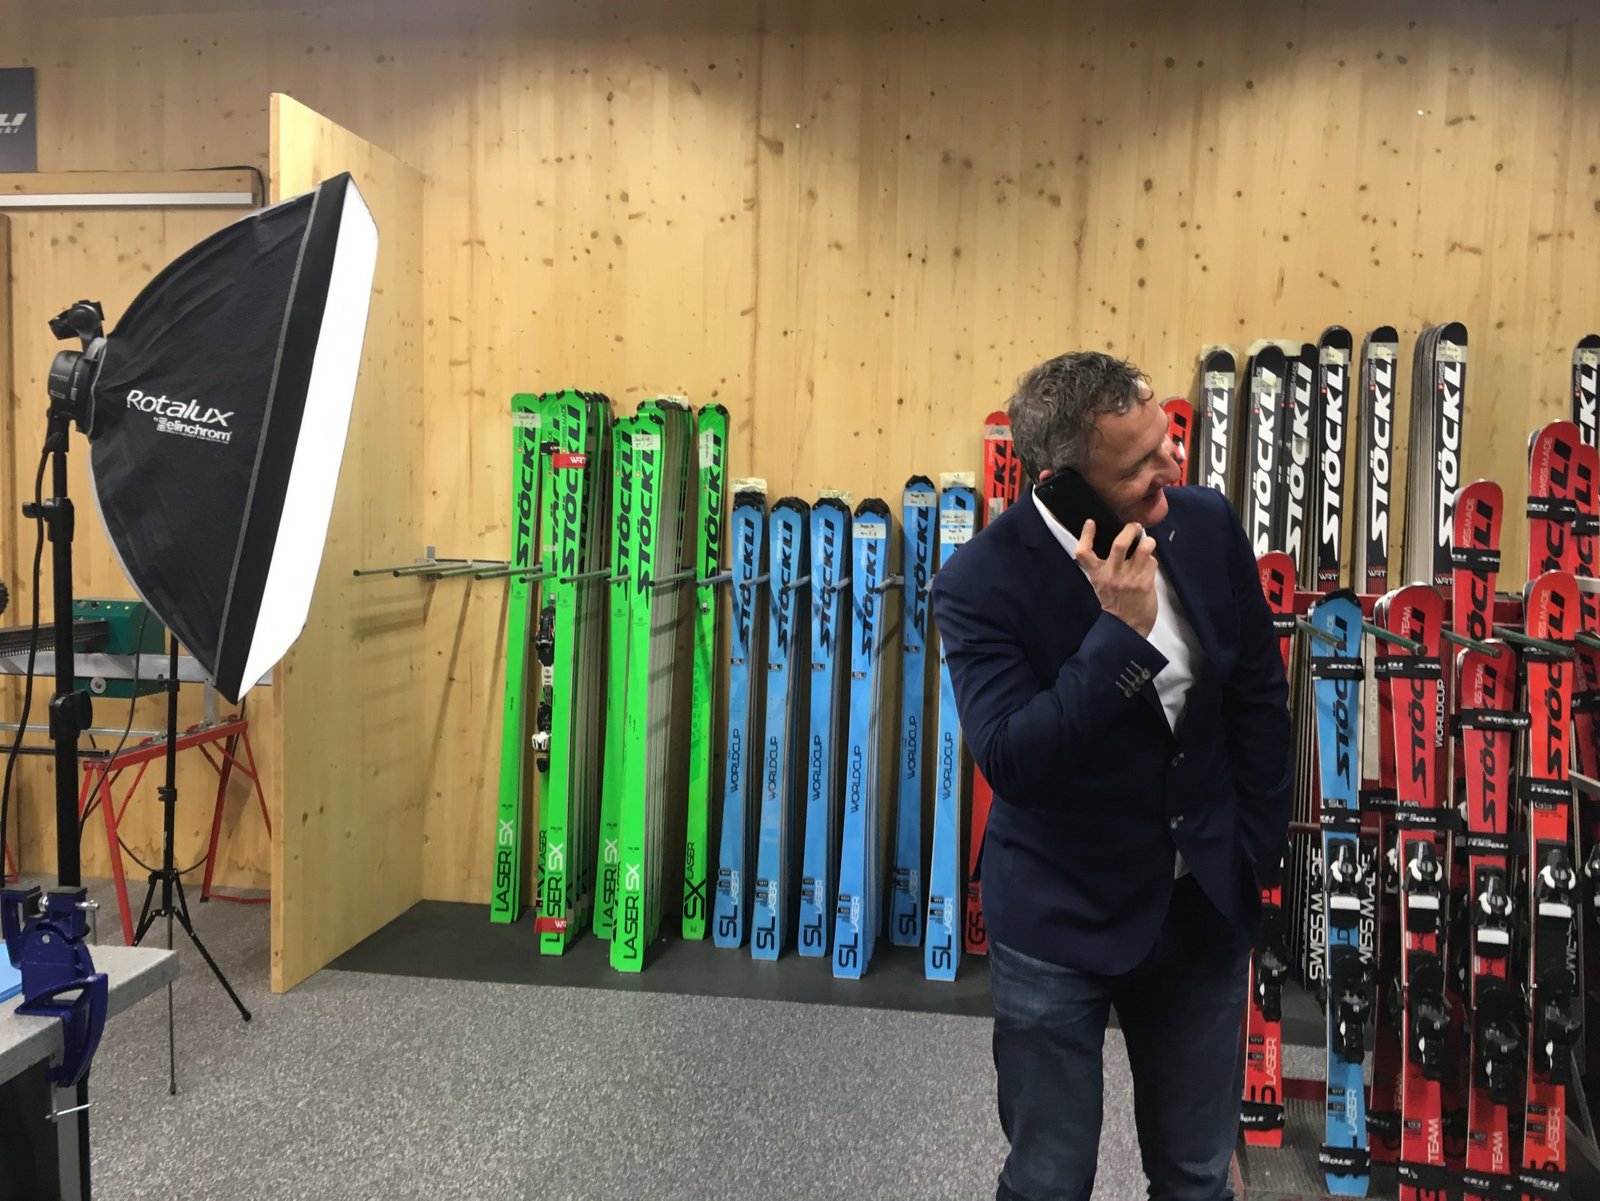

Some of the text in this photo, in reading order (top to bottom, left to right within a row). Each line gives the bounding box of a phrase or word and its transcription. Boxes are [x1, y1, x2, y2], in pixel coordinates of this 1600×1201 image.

[126, 389, 235, 427] Rotalux
[166, 419, 232, 442] elinchrom
[1207, 371, 1229, 496] ÖCKLI
[1286, 362, 1313, 572] STÖCKLI
[1323, 346, 1344, 561] STÖCKLI
[1370, 347, 1392, 558] STÖCKLI
[515, 406, 537, 579] STÖCKL
[637, 428, 655, 609] STÖCKL
[740, 517, 755, 655] STÖCKLI
[777, 520, 793, 659] STÖCKLI
[819, 517, 835, 659] STÖCKLI
[861, 539, 878, 668] STÖCKL
[914, 505, 928, 642] STÖCKL
[1319, 573, 1338, 581] WRT
[1367, 569, 1387, 577] WRT
[1434, 577, 1453, 585] WRT
[1401, 606, 1412, 635] TEAM
[1333, 615, 1350, 791] STÖCI
[1408, 606, 1427, 799] STÖCLI
[1474, 663, 1485, 690] TEAM
[1545, 590, 1566, 780] STÖCLI
[908, 715, 917, 780] WORLDCUP
[1435, 678, 1445, 748] WORLDCUP
[731, 728, 741, 793] WORLDCUP
[768, 736, 778, 801] WORLDCUP
[812, 735, 822, 801] WORLDCUP
[851, 745, 861, 814] WORLDCUP
[943, 731, 954, 800] WORLDCUP
[495, 818, 514, 912] LASER SX
[604, 838, 618, 864] SX
[685, 841, 695, 879] LASER
[545, 842, 564, 943] LSER SX
[623, 863, 641, 959] LASER SX
[718, 870, 739, 938] SL LASER
[756, 880, 778, 950] SL LASER
[803, 880, 824, 947] SL LASER
[899, 870, 918, 936] SL LASER
[838, 895, 861, 969] SL LASER
[932, 897, 953, 970] SL LASER
[1265, 1037, 1277, 1086] LASER
[1346, 1088, 1358, 1135] LASER
[1427, 1118, 1440, 1163] TEAM
[1548, 1107, 1561, 1161] LASER
[1492, 1131, 1503, 1172] TEAM
